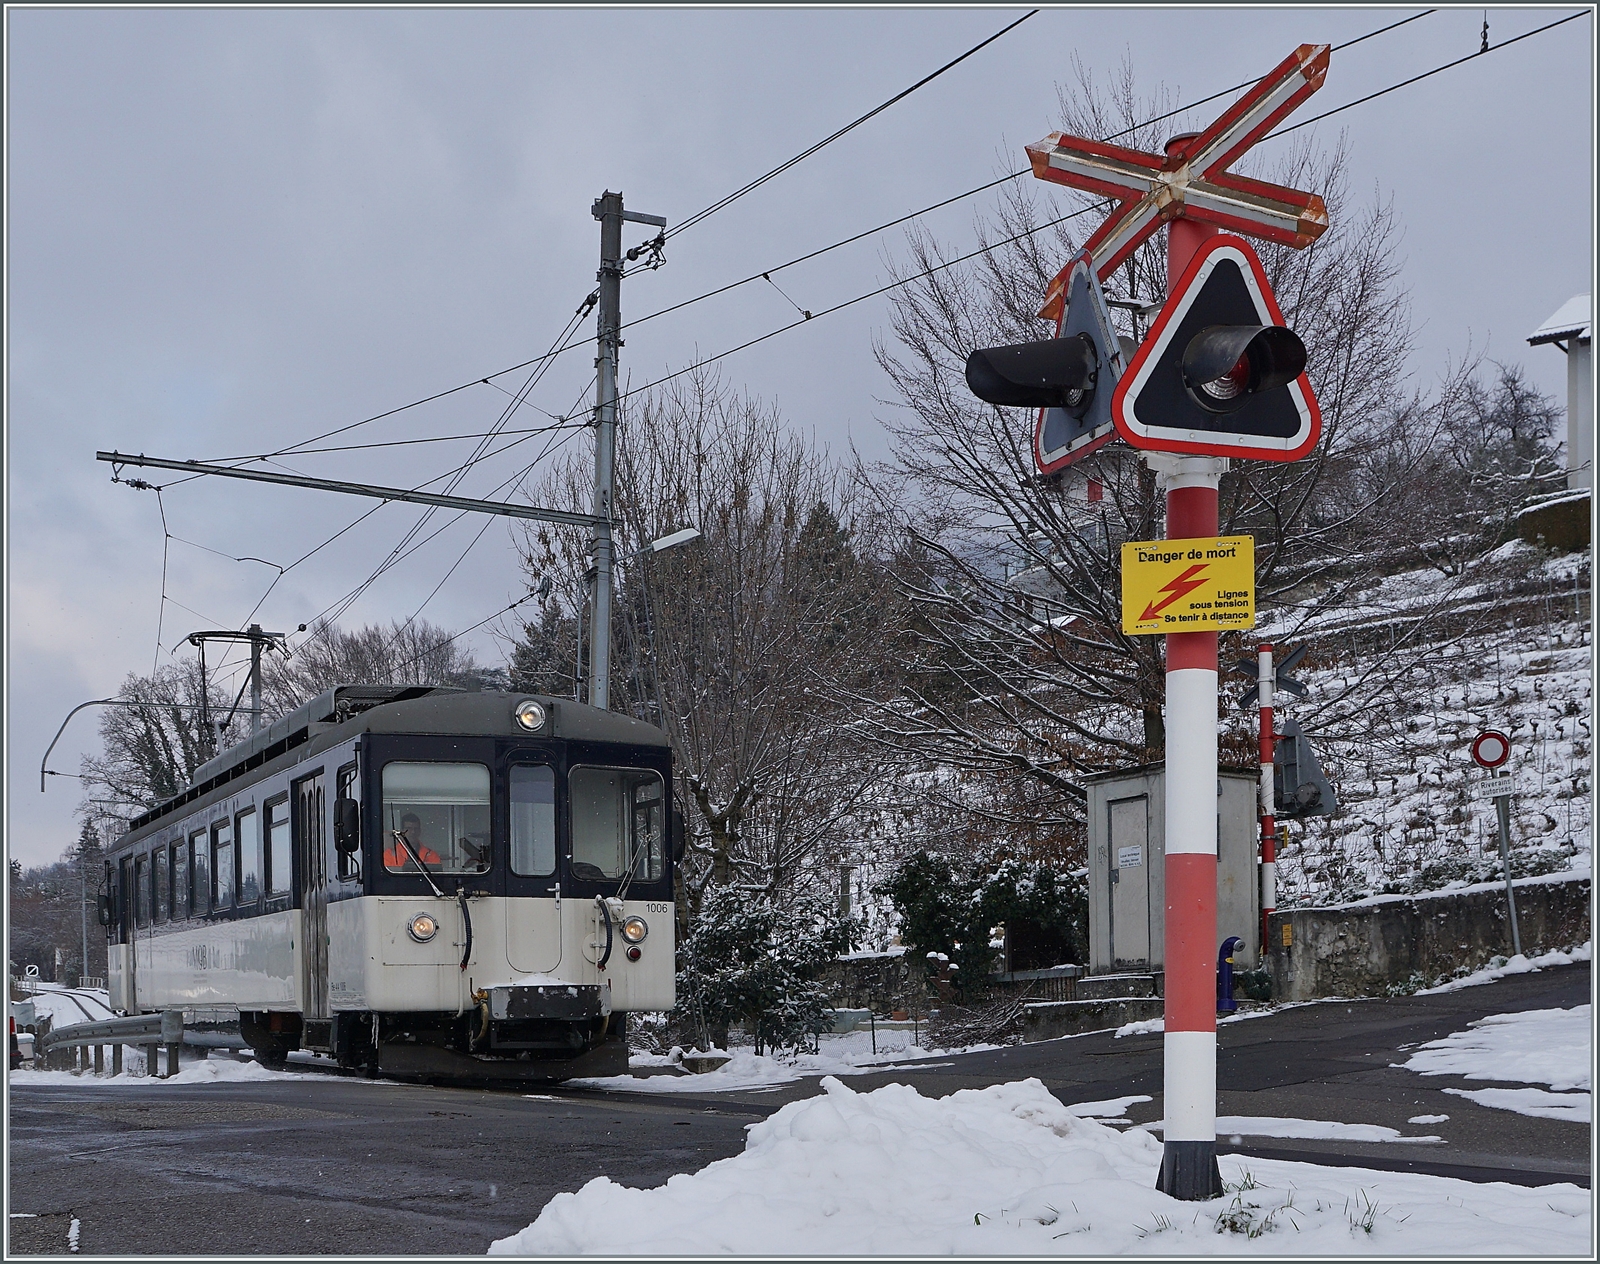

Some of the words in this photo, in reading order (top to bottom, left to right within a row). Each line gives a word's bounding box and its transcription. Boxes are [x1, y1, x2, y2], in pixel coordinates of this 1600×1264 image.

[1138, 551, 1184, 563] Danger
[1187, 549, 1202, 559] de
[1206, 547, 1236, 558] mort
[1217, 590, 1249, 600] Lignes
[1189, 601, 1212, 609] sous
[1214, 599, 1249, 608] tension
[1164, 614, 1177, 622] Se
[1178, 613, 1200, 622] tenir
[1202, 612, 1208, 620] à
[1210, 611, 1249, 620] distance
[1480, 779, 1511, 789] Riverains
[646, 903, 668, 913] 1006
